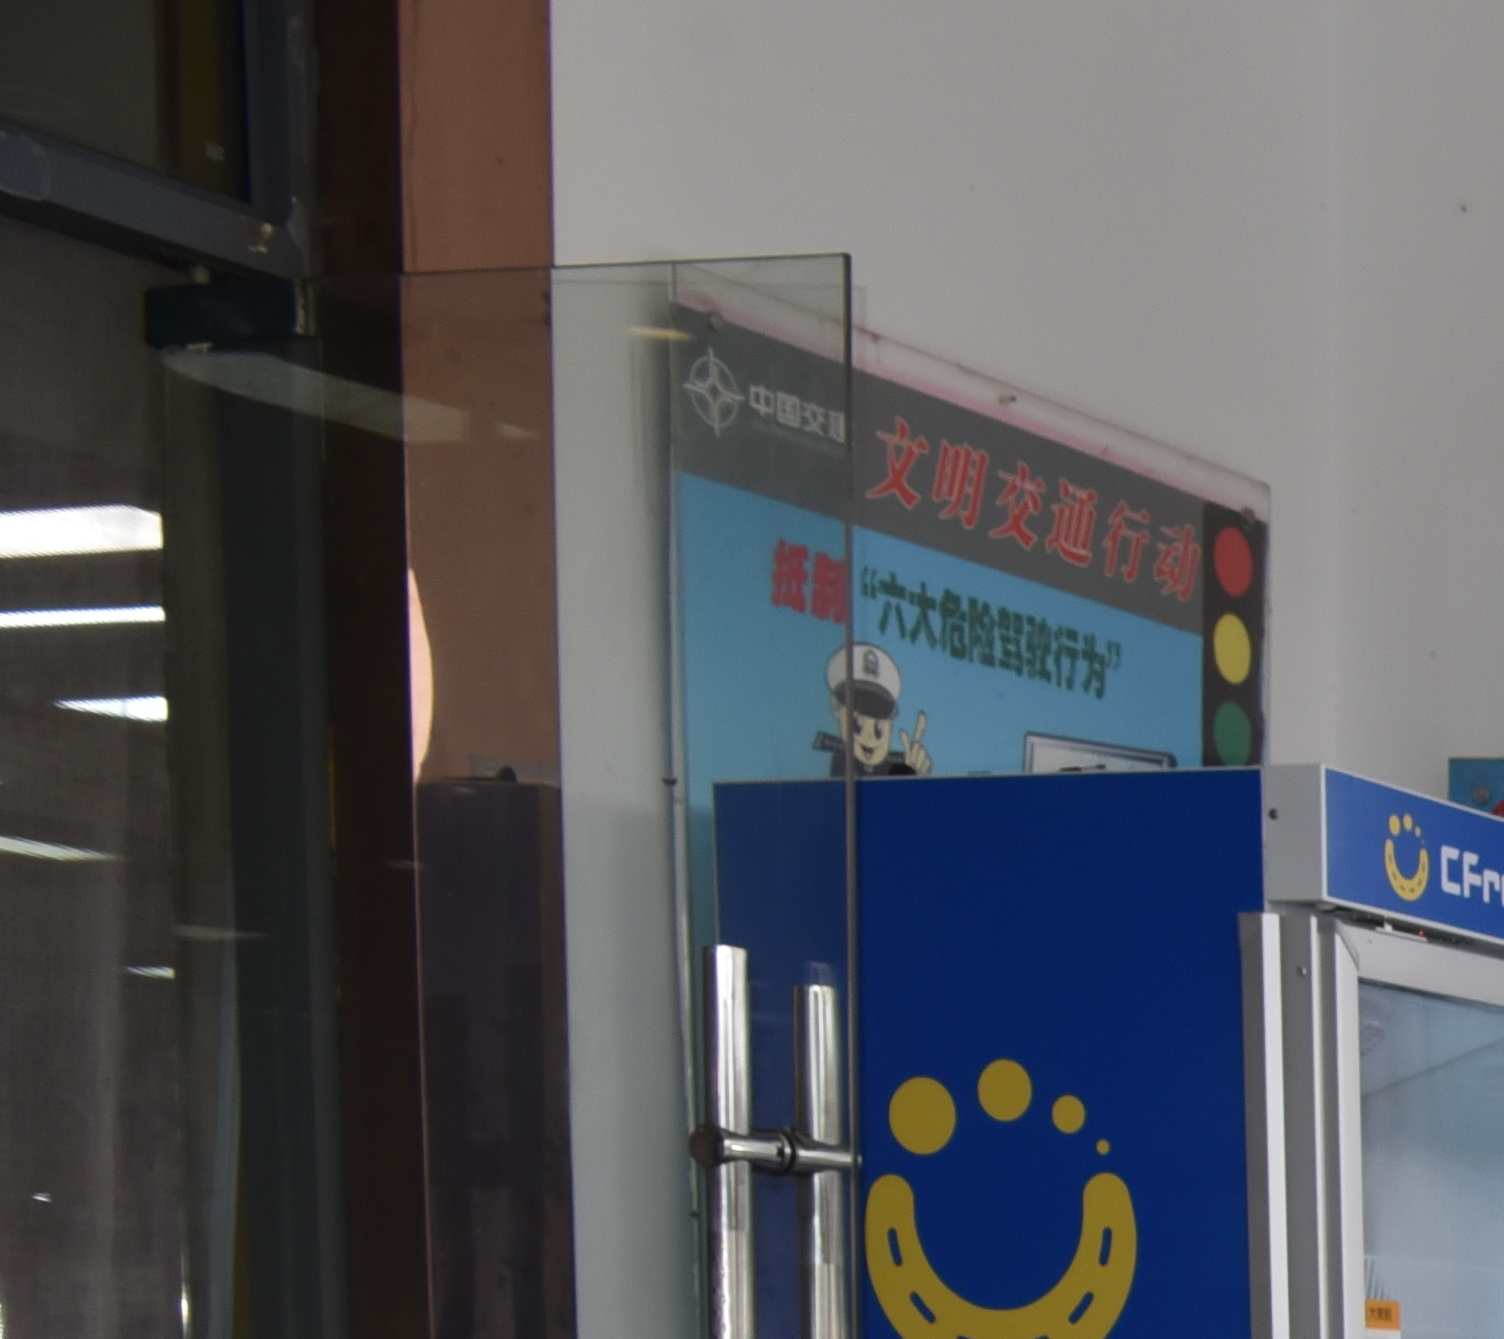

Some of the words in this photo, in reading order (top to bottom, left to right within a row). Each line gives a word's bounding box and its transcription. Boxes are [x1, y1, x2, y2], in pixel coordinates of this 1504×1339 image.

[866, 414, 1202, 602] 文明交通行动
[771, 538, 847, 626] 抵制
[858, 566, 1122, 699] “六大危险驾驶行为”
